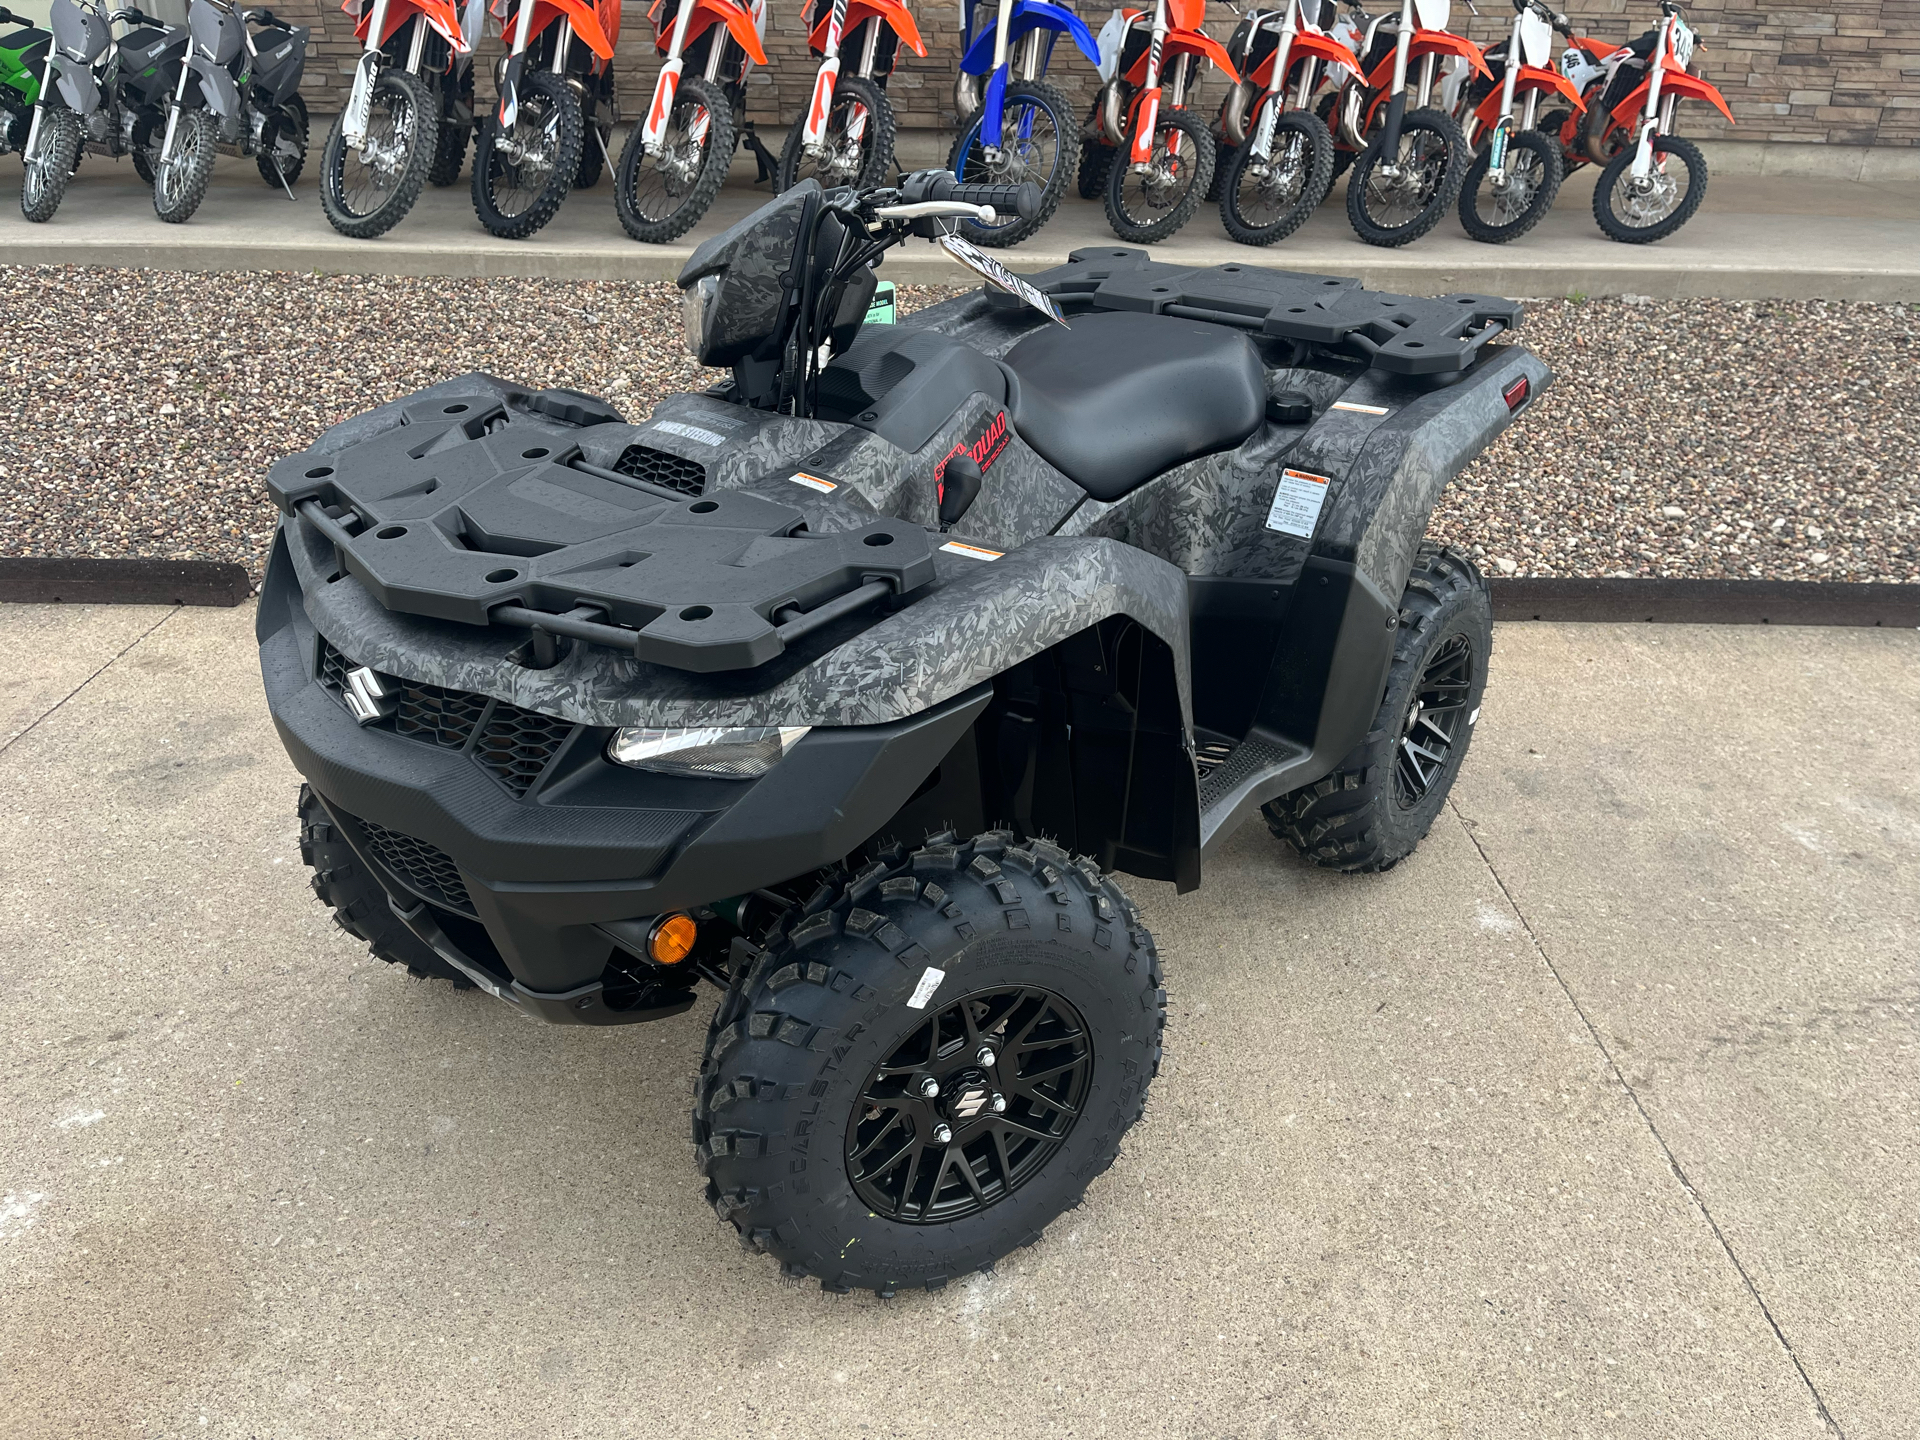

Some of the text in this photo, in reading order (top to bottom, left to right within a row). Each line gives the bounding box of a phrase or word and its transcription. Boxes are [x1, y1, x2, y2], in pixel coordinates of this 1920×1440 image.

[1564, 53, 1580, 69] 346
[360, 62, 379, 129] DUNLOP
[1264, 94, 1284, 159] DUNLOP
[651, 419, 727, 447] POWER STEERING
[789, 1021, 868, 1175] CARLSTAR
